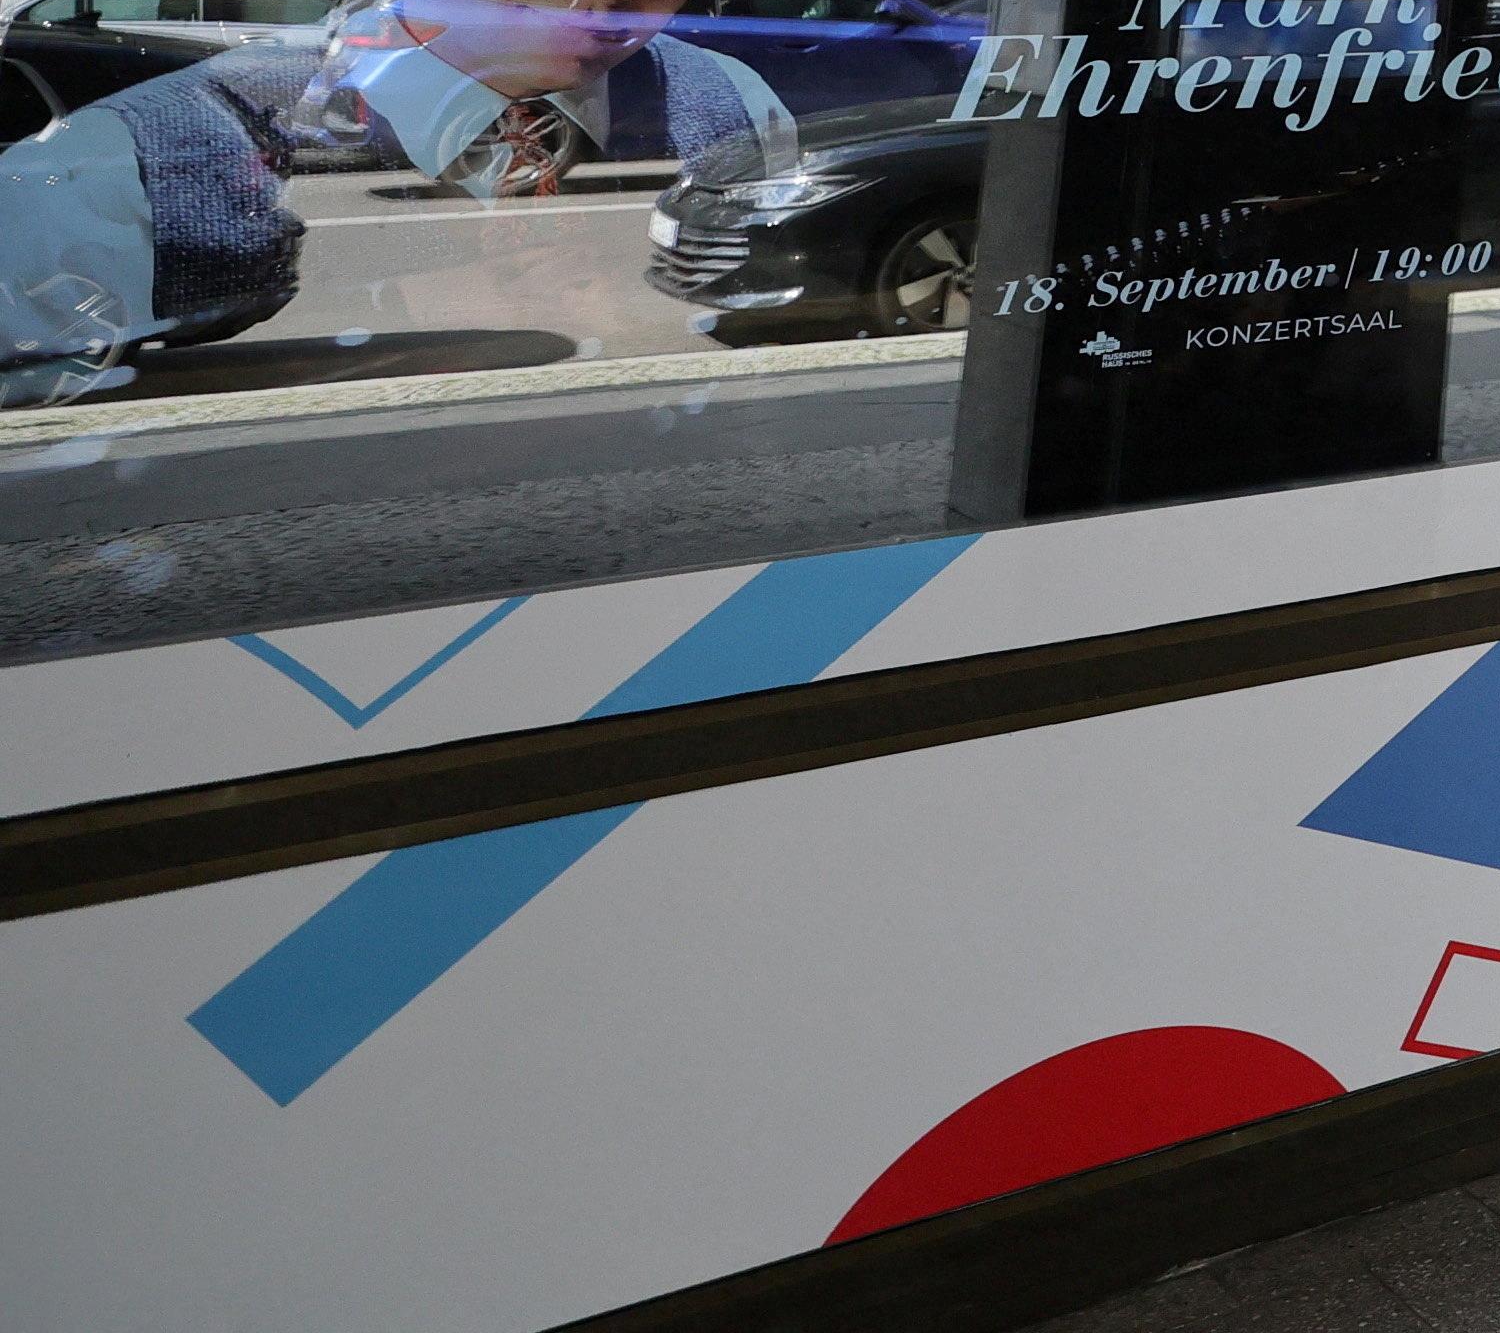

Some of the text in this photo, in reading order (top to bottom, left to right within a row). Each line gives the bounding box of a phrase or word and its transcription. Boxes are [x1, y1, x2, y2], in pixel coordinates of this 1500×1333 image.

[993, 277, 1066, 317] 18.
[1087, 262, 1337, 313] September
[1367, 239, 1494, 284] 19:00
[1185, 310, 1403, 350] KONZERTSAAL
